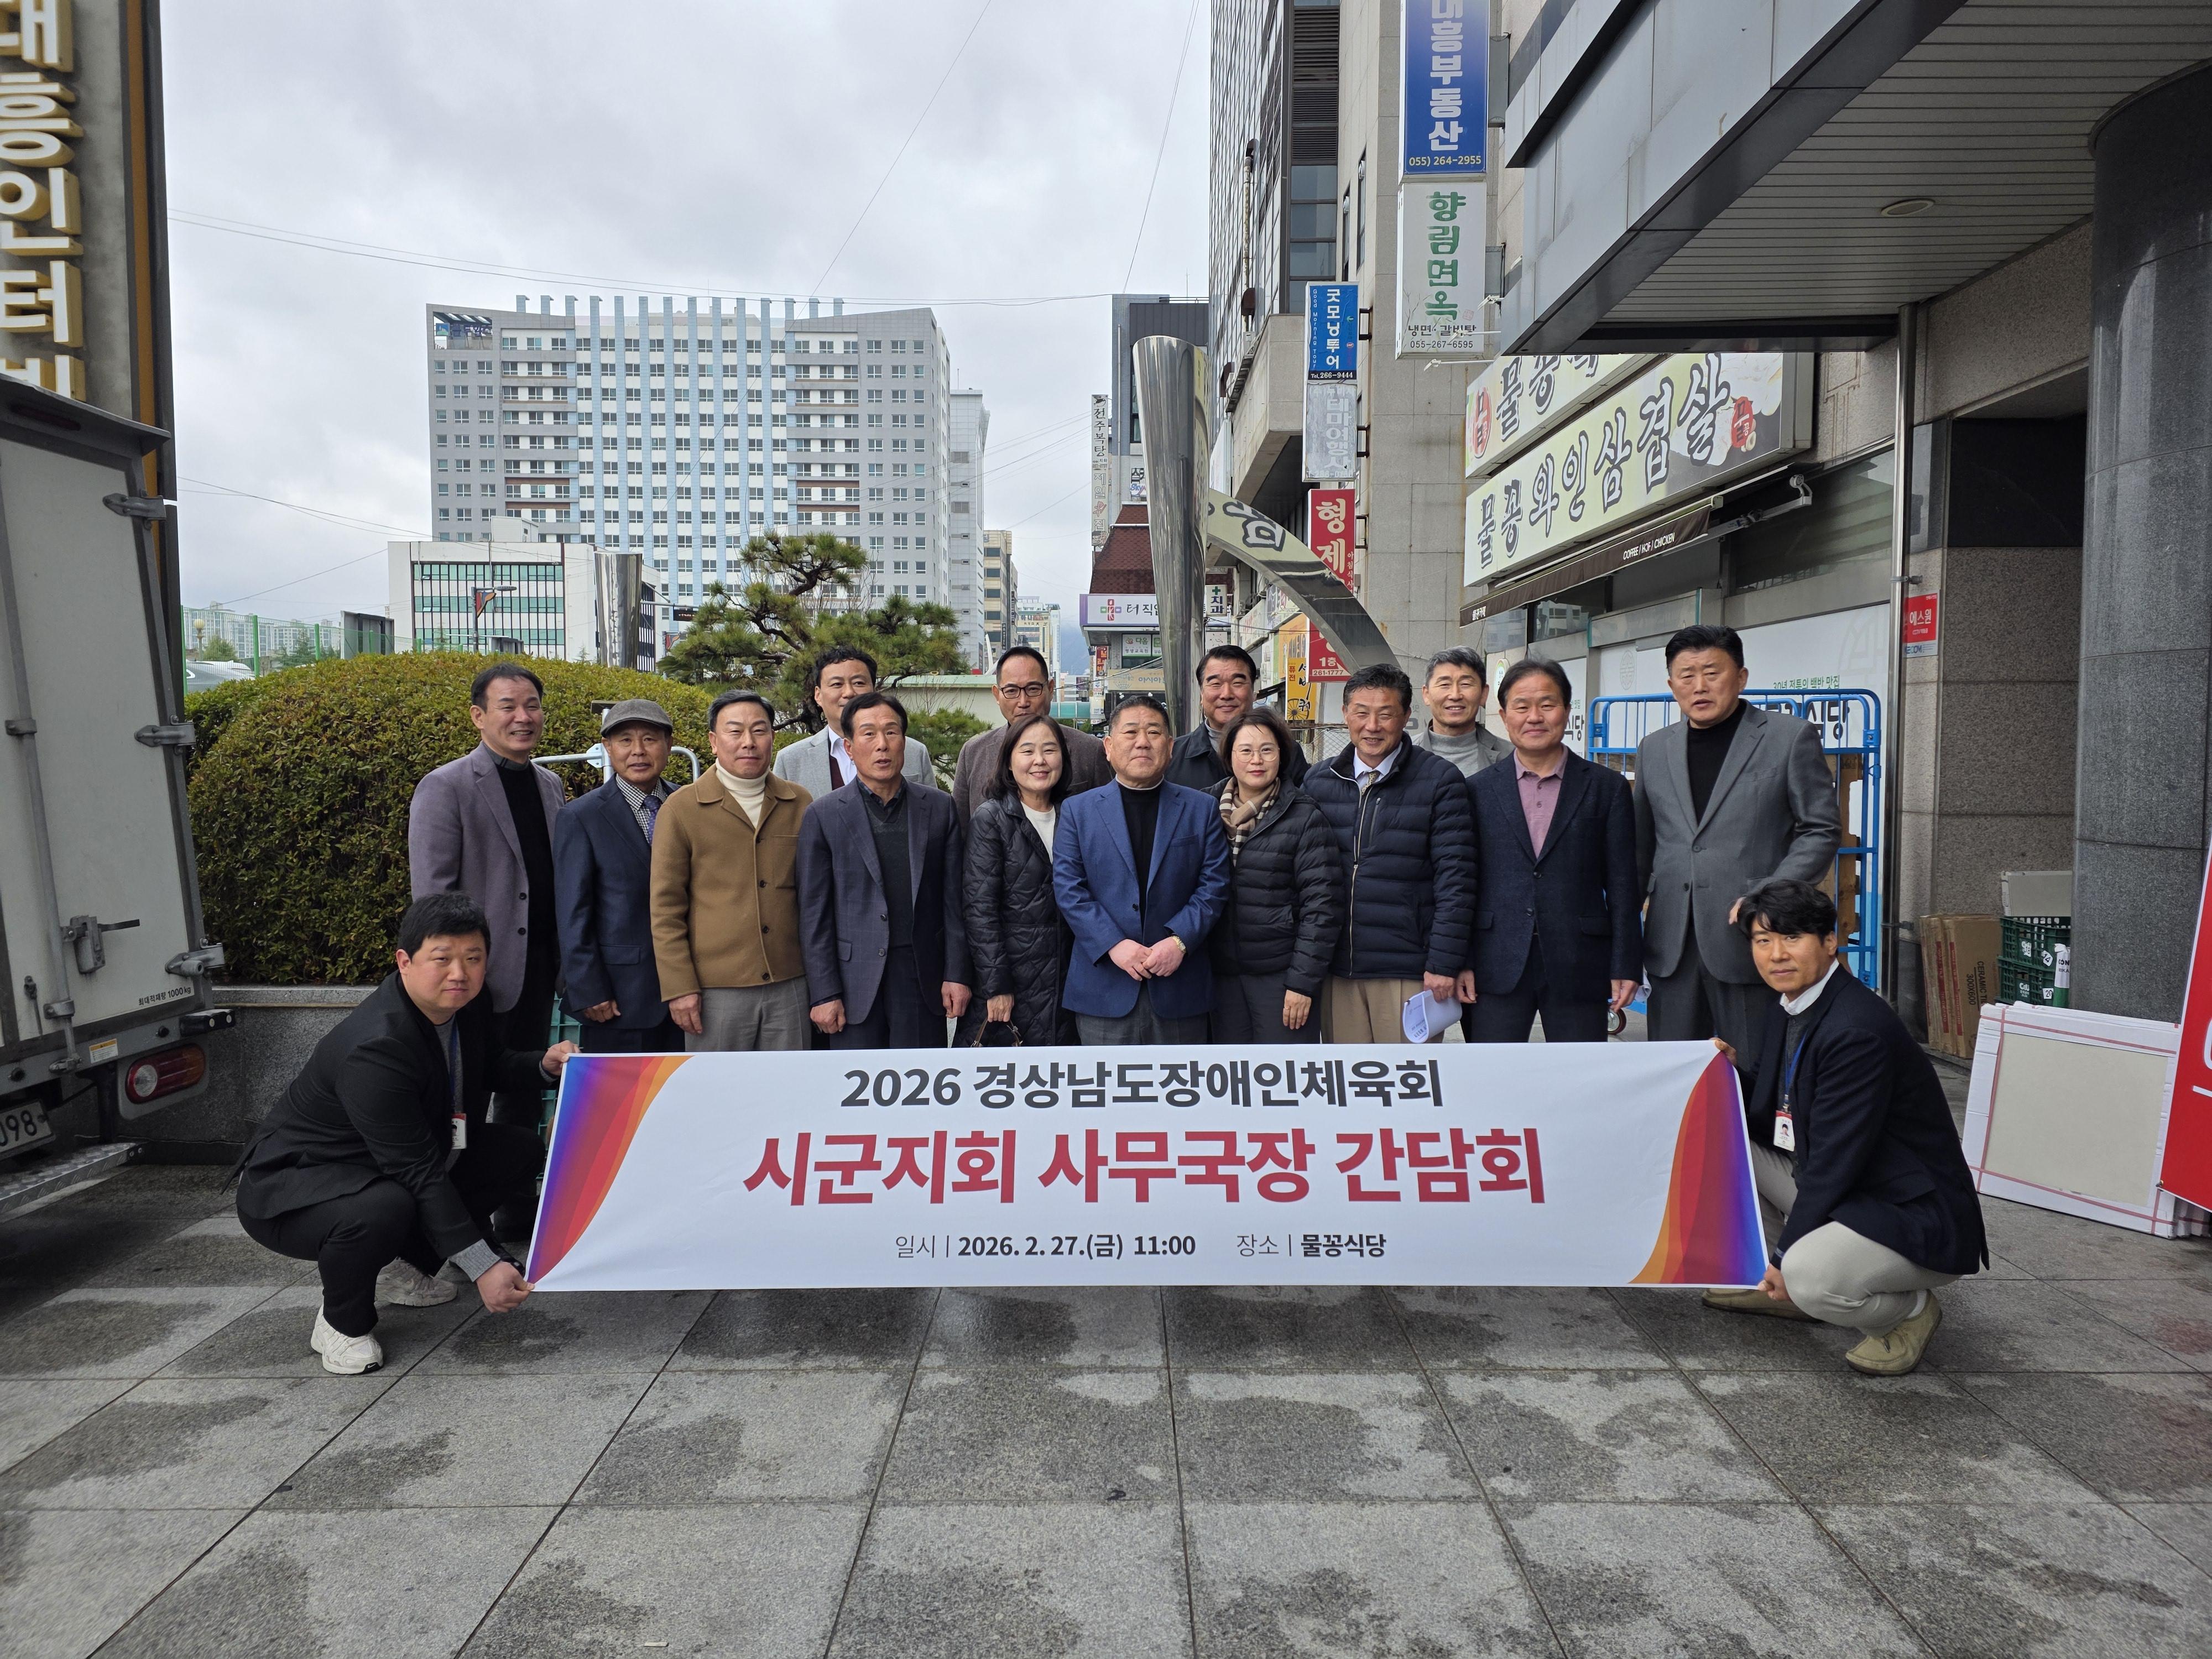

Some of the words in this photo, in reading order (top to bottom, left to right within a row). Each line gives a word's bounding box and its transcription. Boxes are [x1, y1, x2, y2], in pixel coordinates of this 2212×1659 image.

[1409, 156, 1431, 167] 055)
[1433, 155, 1481, 165] 264-2955
[1425, 191, 1467, 320] 향림면옥
[1326, 289, 1340, 369] 굿모닝투어
[1094, 408, 1106, 456] 전주복탕
[1623, 546, 1639, 560] COFFEE
[1642, 541, 1651, 553] HOF
[1654, 533, 1675, 549] CHICKEN
[1211, 596, 1224, 613] 치과
[1910, 608, 1932, 625] 에스원
[1289, 665, 1296, 681] 퓨전
[1319, 657, 1337, 666] 1층
[1966, 973, 1976, 1005] 300X600
[1977, 961, 1987, 994] CERAMIC
[138, 992, 166, 1005] 최대적재량
[168, 987, 184, 998] 1000
[841, 1068, 961, 1107] 2026
[973, 1060, 1443, 1108] 경상남도장애인체육회
[742, 1129, 1016, 1206] 시군지회
[1038, 1128, 1316, 1203] 사무국장
[1335, 1128, 1545, 1203] 간담회
[895, 1235, 935, 1259] 일시
[1134, 1235, 1196, 1255] 11:00
[1237, 1234, 1279, 1257] 장소
[1301, 1234, 1387, 1258] 물꽁식당
